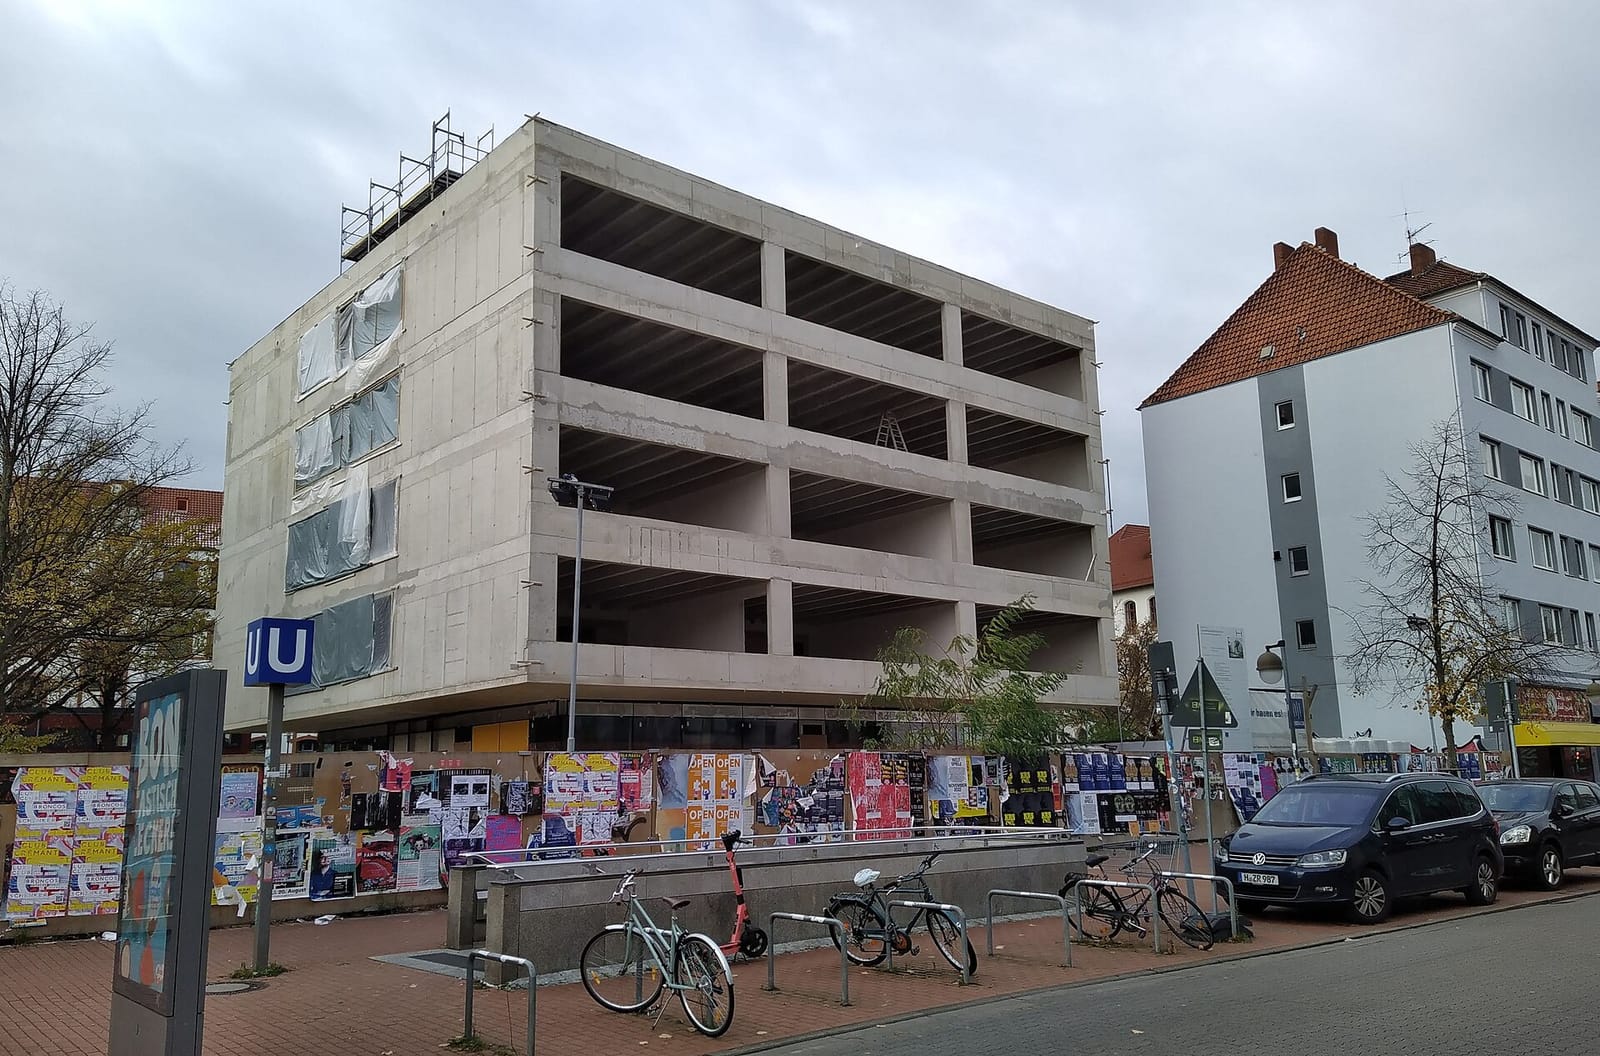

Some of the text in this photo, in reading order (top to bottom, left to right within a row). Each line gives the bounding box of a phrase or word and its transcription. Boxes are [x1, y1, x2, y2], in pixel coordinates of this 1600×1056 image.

[247, 629, 260, 675] U
[268, 627, 307, 673] U
[138, 698, 181, 785] BON
[690, 758, 714, 768] OPEN
[717, 758, 741, 768] OPEN
[690, 810, 714, 820] OPEN
[717, 809, 740, 820] OPEN
